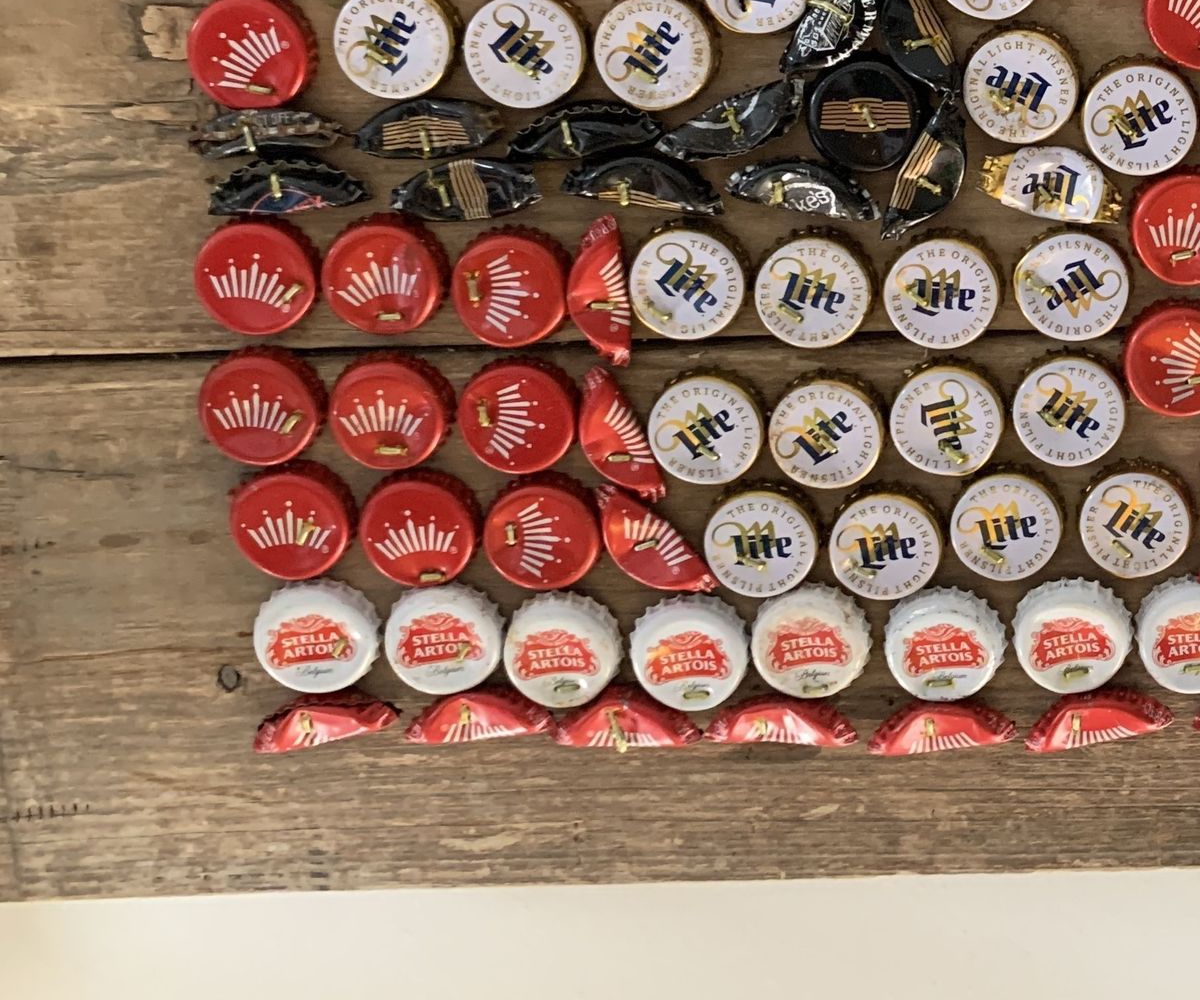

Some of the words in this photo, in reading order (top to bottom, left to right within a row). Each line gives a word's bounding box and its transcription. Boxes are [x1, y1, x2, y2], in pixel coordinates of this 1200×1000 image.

[528, 2, 558, 22] THE
[339, 18, 350, 46] THE
[969, 59, 995, 128] ORIGINAL
[988, 41, 1035, 58] LIGHT
[1039, 48, 1069, 106] PILSNER
[1097, 80, 1122, 102] THE
[1126, 73, 1190, 116] ORIGINAL
[1165, 120, 1191, 162] LIGHT
[1100, 144, 1160, 170] PILSNER
[917, 249, 946, 260] THE
[1049, 240, 1110, 263] PILSNER
[655, 257, 717, 313] Lite
[689, 240, 718, 257] THE
[708, 257, 736, 328] ORIGINAL
[779, 271, 845, 314] Lite
[797, 247, 827, 258] THE
[832, 255, 861, 320] ORIGINAL
[951, 251, 991, 312] ORIGINAL
[892, 293, 935, 343] PILSNER
[941, 316, 983, 344] LIGHT
[1027, 298, 1092, 336] ORIGINAL
[1097, 304, 1119, 327] THE
[1067, 367, 1097, 382] THE
[682, 387, 748, 423] ORIGINAL
[896, 382, 931, 434] PILSNER
[973, 391, 992, 416] THE
[1093, 381, 1118, 452] ORIGINAL
[776, 400, 794, 426] THE
[798, 391, 866, 422] ORIGINAL
[855, 425, 872, 468] LIGHT
[899, 438, 939, 469] LIGHT
[1045, 448, 1094, 462] LIGHT
[727, 503, 755, 518] THE
[850, 506, 878, 521] THE
[1102, 500, 1165, 550] Lite
[760, 503, 808, 556] ORIGINAL
[883, 506, 932, 558] ORIGINAL
[970, 486, 996, 503] THE
[1015, 539, 1051, 574] LIGHT
[976, 515, 1037, 550] Lite
[1086, 506, 1109, 561] PILSNER
[1159, 494, 1182, 562] ORIGINAL
[856, 535, 916, 571] Lite
[769, 560, 805, 591] LIGHT
[894, 562, 930, 594] LIGHT
[281, 631, 340, 647] STELLA
[412, 632, 468, 646] STELLA
[527, 647, 583, 659] STELLA
[781, 639, 834, 651] STELLA
[916, 642, 971, 655] STELLA
[1043, 632, 1098, 648] STELLA
[1046, 643, 1100, 660] ARTOIS
[530, 657, 585, 670] ARTOIS
[660, 649, 715, 664] STELLA
[661, 659, 717, 675] ARTOIS
[783, 648, 837, 663] ARTOIS
[919, 651, 973, 666] ARTOIS
